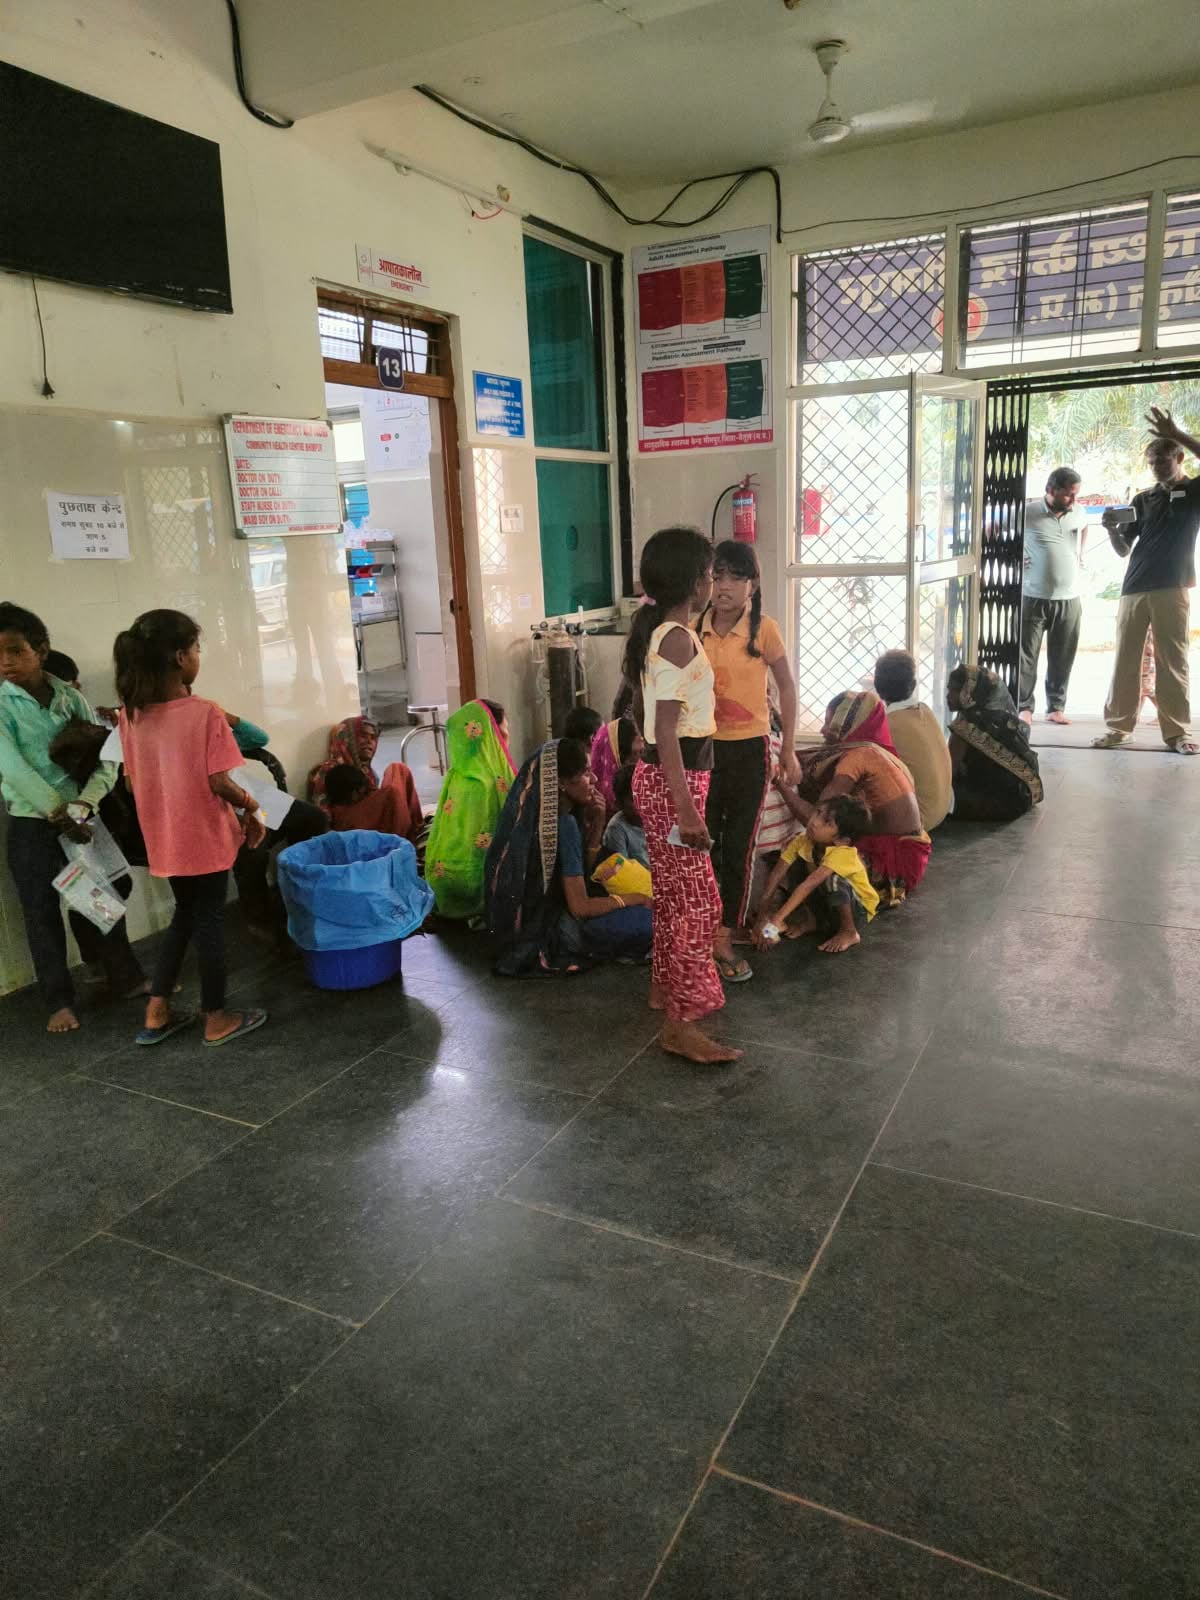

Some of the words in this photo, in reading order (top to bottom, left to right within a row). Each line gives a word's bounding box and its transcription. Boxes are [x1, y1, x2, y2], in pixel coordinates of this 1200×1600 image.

[648, 253, 664, 262] Adult
[666, 247, 700, 258] Assessment
[700, 244, 726, 254] Pathway
[681, 348, 716, 358] Assessment
[716, 346, 742, 355] Pathway
[382, 359, 401, 378] 13
[237, 473, 257, 484] DOCTOR
[258, 473, 266, 484] ON
[239, 487, 259, 498] DOCTOR
[260, 487, 268, 498] ON
[256, 501, 273, 512] NURSE
